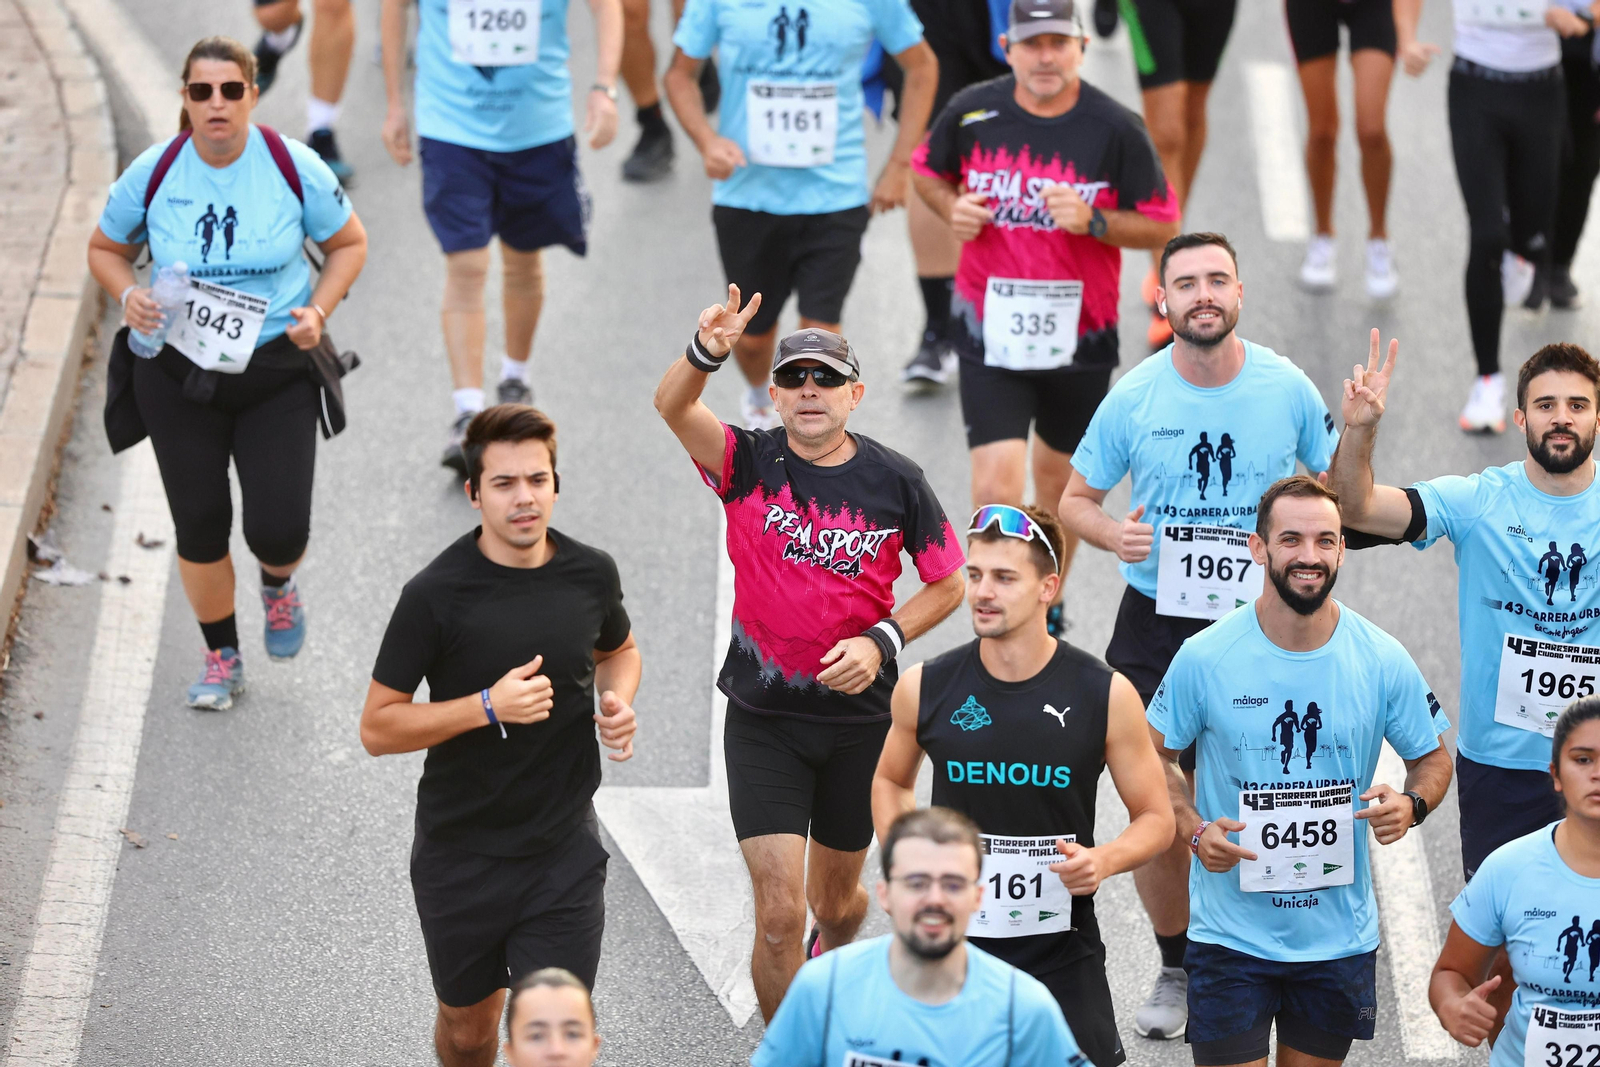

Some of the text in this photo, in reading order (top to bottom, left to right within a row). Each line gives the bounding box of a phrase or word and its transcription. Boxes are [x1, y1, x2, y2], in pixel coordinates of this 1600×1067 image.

[467, 9, 527, 31] 1260
[764, 109, 822, 132] 1161
[184, 300, 244, 340] 1943
[1010, 312, 1057, 336] 335
[1152, 427, 1185, 438] málaga
[1164, 504, 1177, 518] 43
[1179, 507, 1230, 518] CARRERA
[1165, 526, 1194, 542] 43
[1195, 526, 1235, 537] CARRERA
[1194, 534, 1220, 542] CIUDAD
[814, 528, 901, 563] SPORT
[1180, 553, 1253, 583] 1967
[1504, 601, 1524, 616] 43
[1525, 608, 1577, 623] CARRERA
[1507, 636, 1600, 658] 43 CARRERA URB
[1537, 649, 1564, 660] CIUDAD
[1520, 668, 1596, 700] 1965
[1232, 694, 1269, 707] málaga
[946, 760, 1072, 789] DENOUS
[1260, 780, 1314, 791] CARRERA
[1243, 786, 1352, 811] 43 CARRERA URBANA
[1275, 800, 1303, 808] CIUDAD
[993, 838, 1036, 848] CARRERA
[1261, 818, 1338, 850] 6458
[993, 847, 1021, 855] CIUDAD
[989, 872, 1043, 901] 161
[1271, 893, 1319, 910] Unicaja
[1523, 907, 1557, 919] málaga
[1543, 987, 1595, 999] CARRERA
[1357, 1006, 1377, 1021] FIL
[1533, 1006, 1558, 1030] 43
[1558, 1021, 1586, 1030] CIUDAD
[1545, 1041, 1600, 1067] 322
